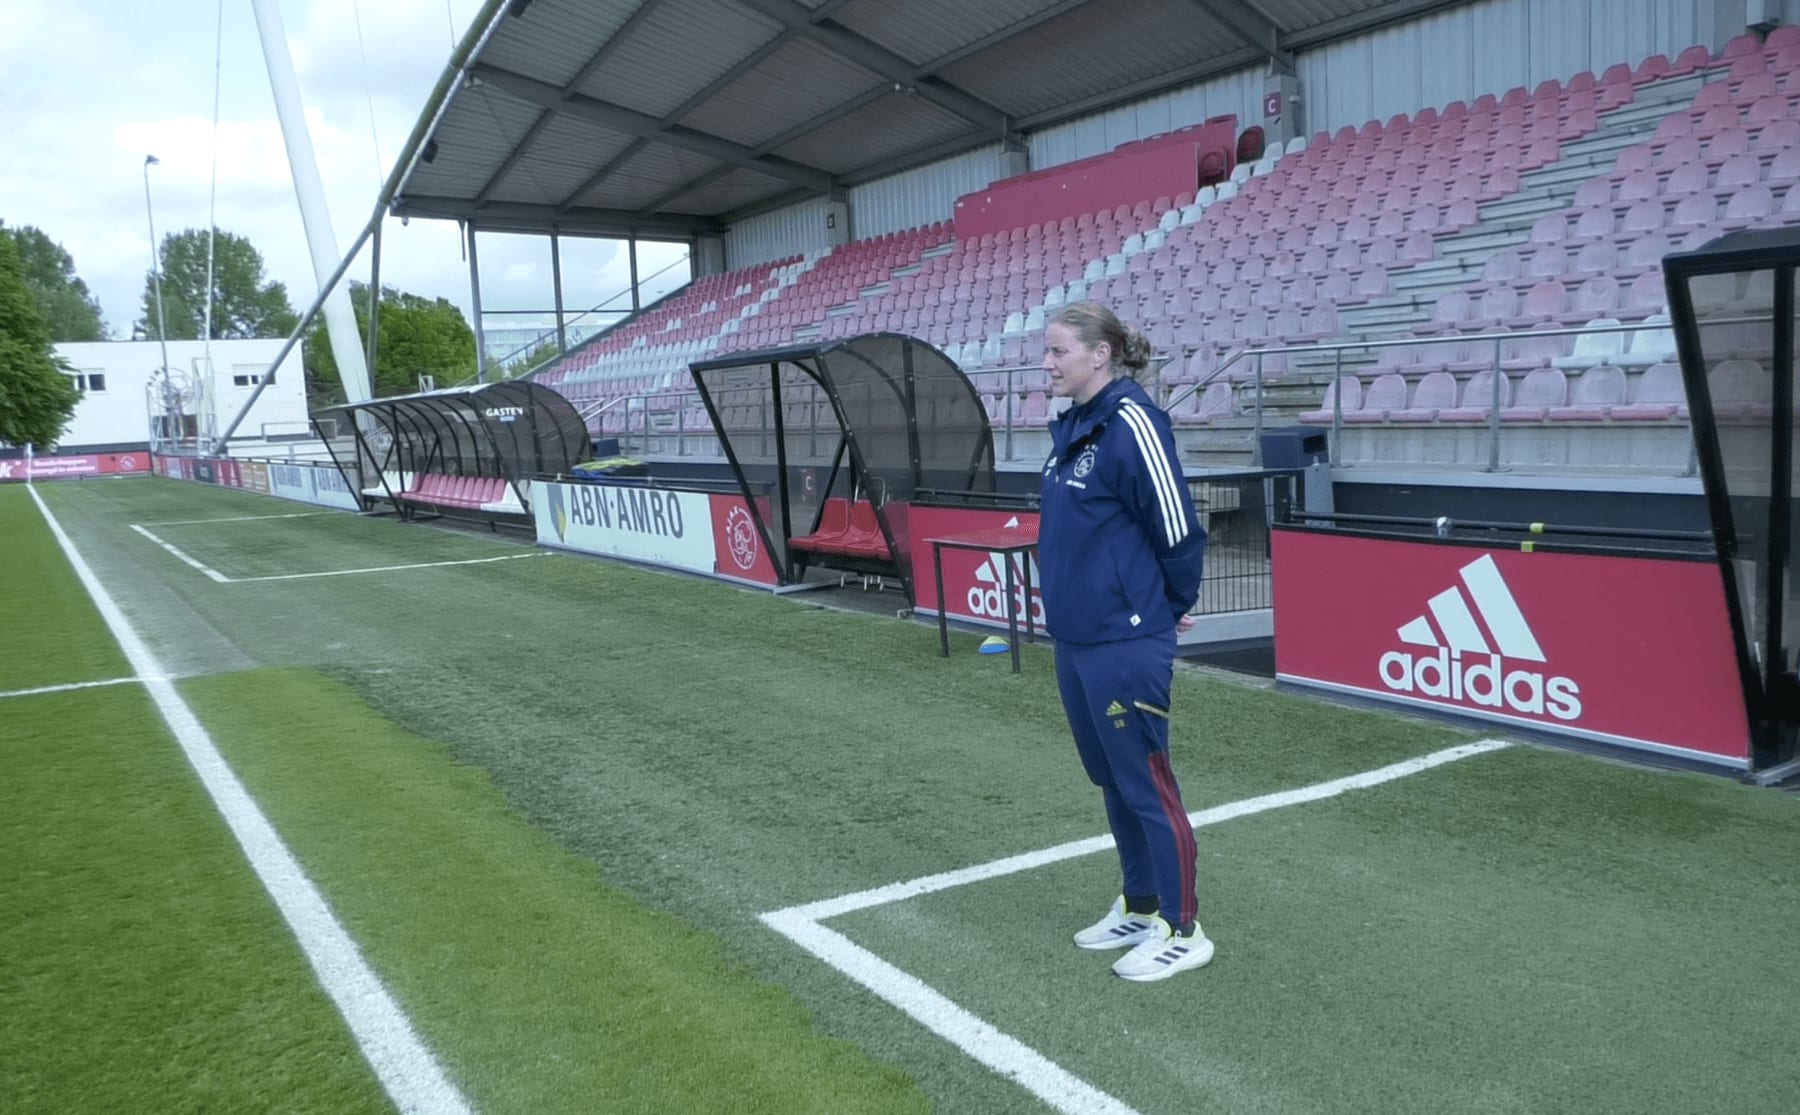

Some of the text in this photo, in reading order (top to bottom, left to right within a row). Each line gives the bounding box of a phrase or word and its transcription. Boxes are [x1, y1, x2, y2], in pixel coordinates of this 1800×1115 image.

[1268, 99, 1277, 113] C
[967, 581, 1047, 625] adida
[1378, 646, 1582, 720] adidas
